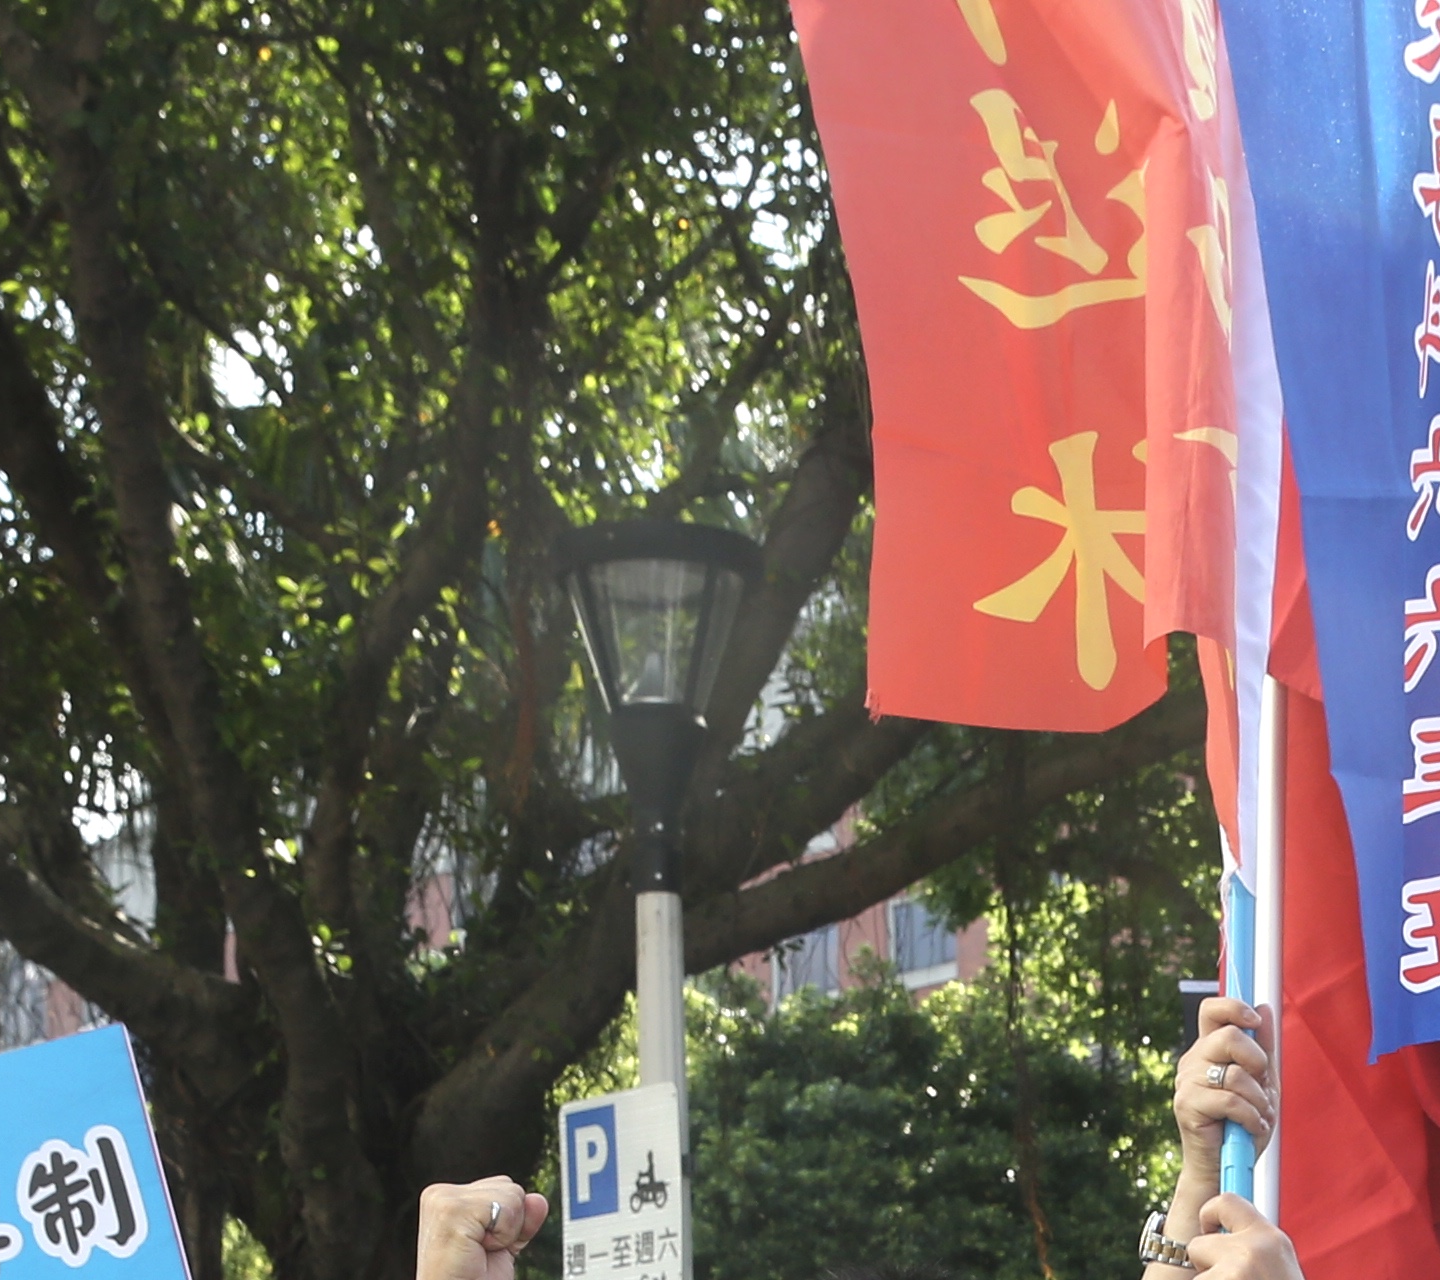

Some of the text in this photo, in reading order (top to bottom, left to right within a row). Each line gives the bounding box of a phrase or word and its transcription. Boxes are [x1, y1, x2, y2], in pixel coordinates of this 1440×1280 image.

[575, 1124, 609, 1204] P
[567, 1227, 678, 1277] 週一至週六
